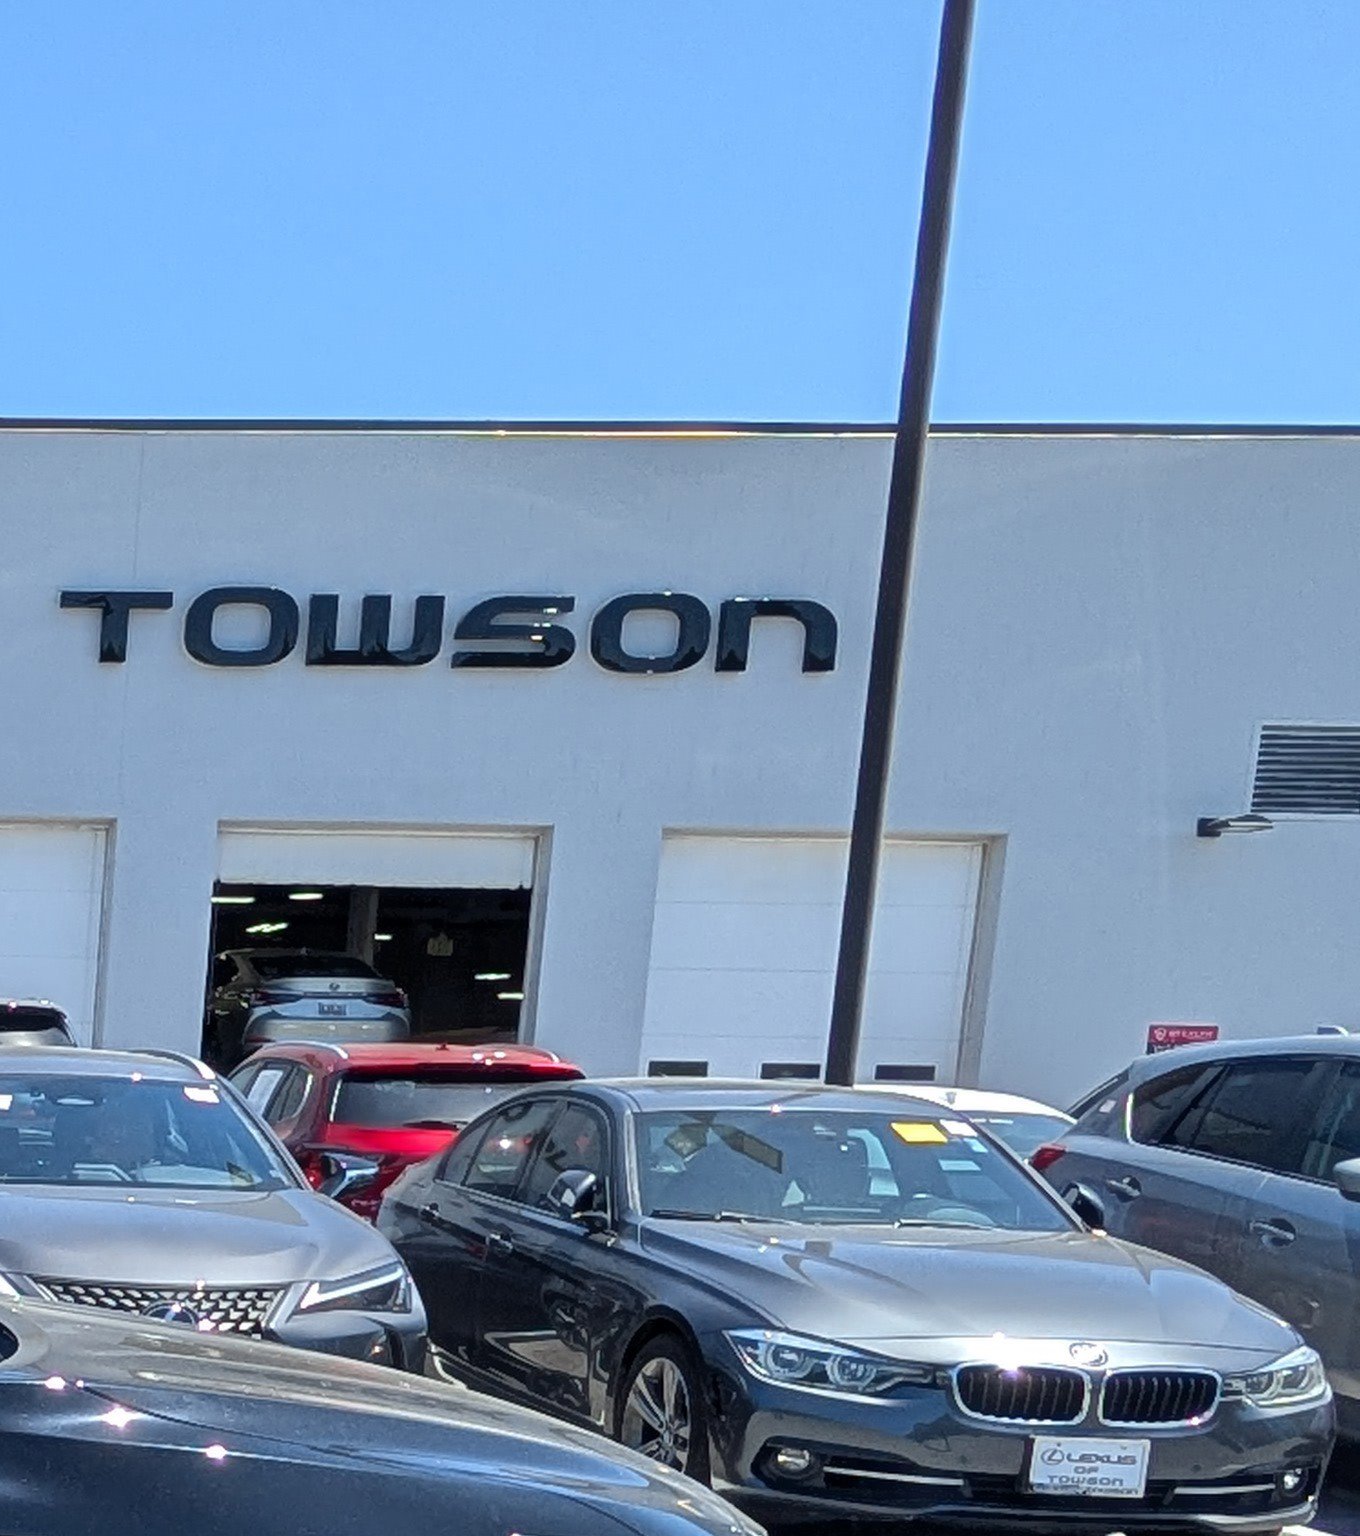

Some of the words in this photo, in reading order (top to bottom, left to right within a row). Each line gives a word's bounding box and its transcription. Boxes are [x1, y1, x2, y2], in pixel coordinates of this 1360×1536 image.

[59, 586, 838, 673] TOWSON
[1066, 1453, 1137, 1465] LEXUS
[1074, 1466, 1099, 1474] OF
[1047, 1475, 1124, 1486] TOWSON
